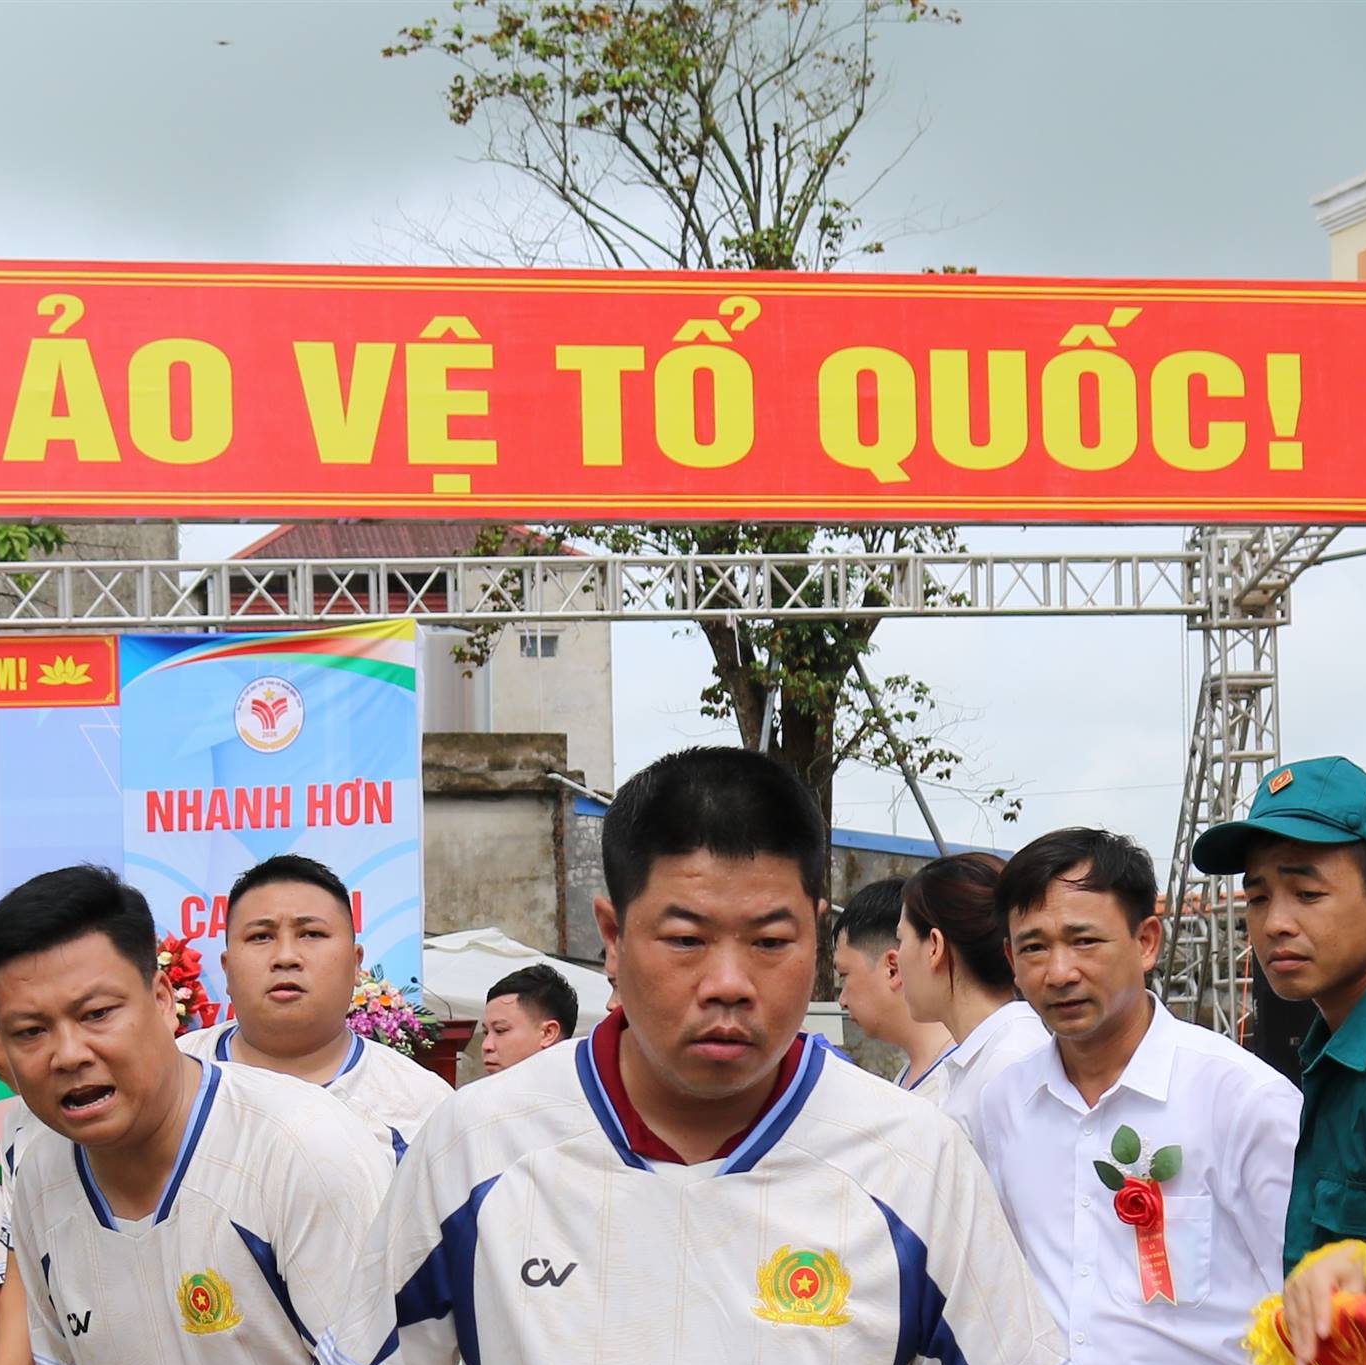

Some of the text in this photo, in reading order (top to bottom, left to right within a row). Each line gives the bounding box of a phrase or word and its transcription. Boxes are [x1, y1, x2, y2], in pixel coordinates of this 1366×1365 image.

[294, 316, 498, 494] VỆ
[556, 296, 761, 468] TỔ
[819, 307, 1303, 483] QUỐC!
[146, 778, 393, 833] NHANH HƠN
[181, 894, 229, 940] CA
